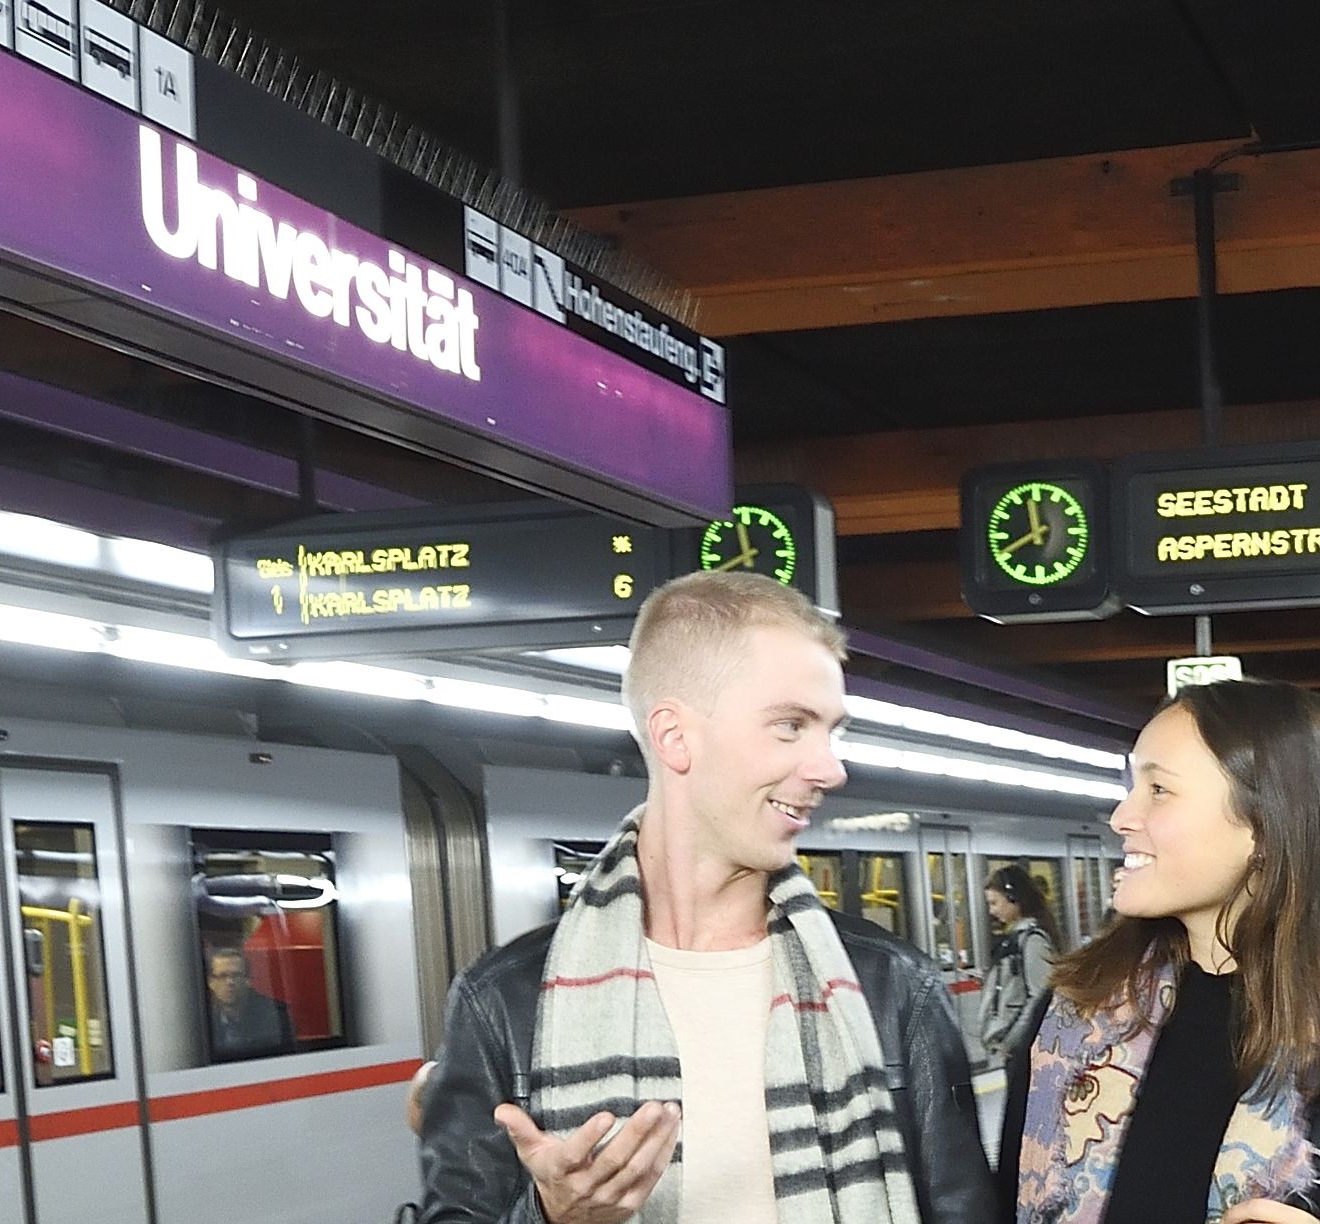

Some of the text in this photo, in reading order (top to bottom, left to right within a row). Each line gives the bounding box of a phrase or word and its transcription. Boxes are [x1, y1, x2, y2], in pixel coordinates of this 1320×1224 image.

[154, 65, 178, 101] 1A
[138, 122, 483, 381] Universität
[563, 270, 702, 384] Hohenstaufeng.
[1156, 482, 1308, 519] SEESTADT
[307, 543, 471, 577] KARLSPLATZ
[309, 574, 634, 618] KARLSPLATZ 6
